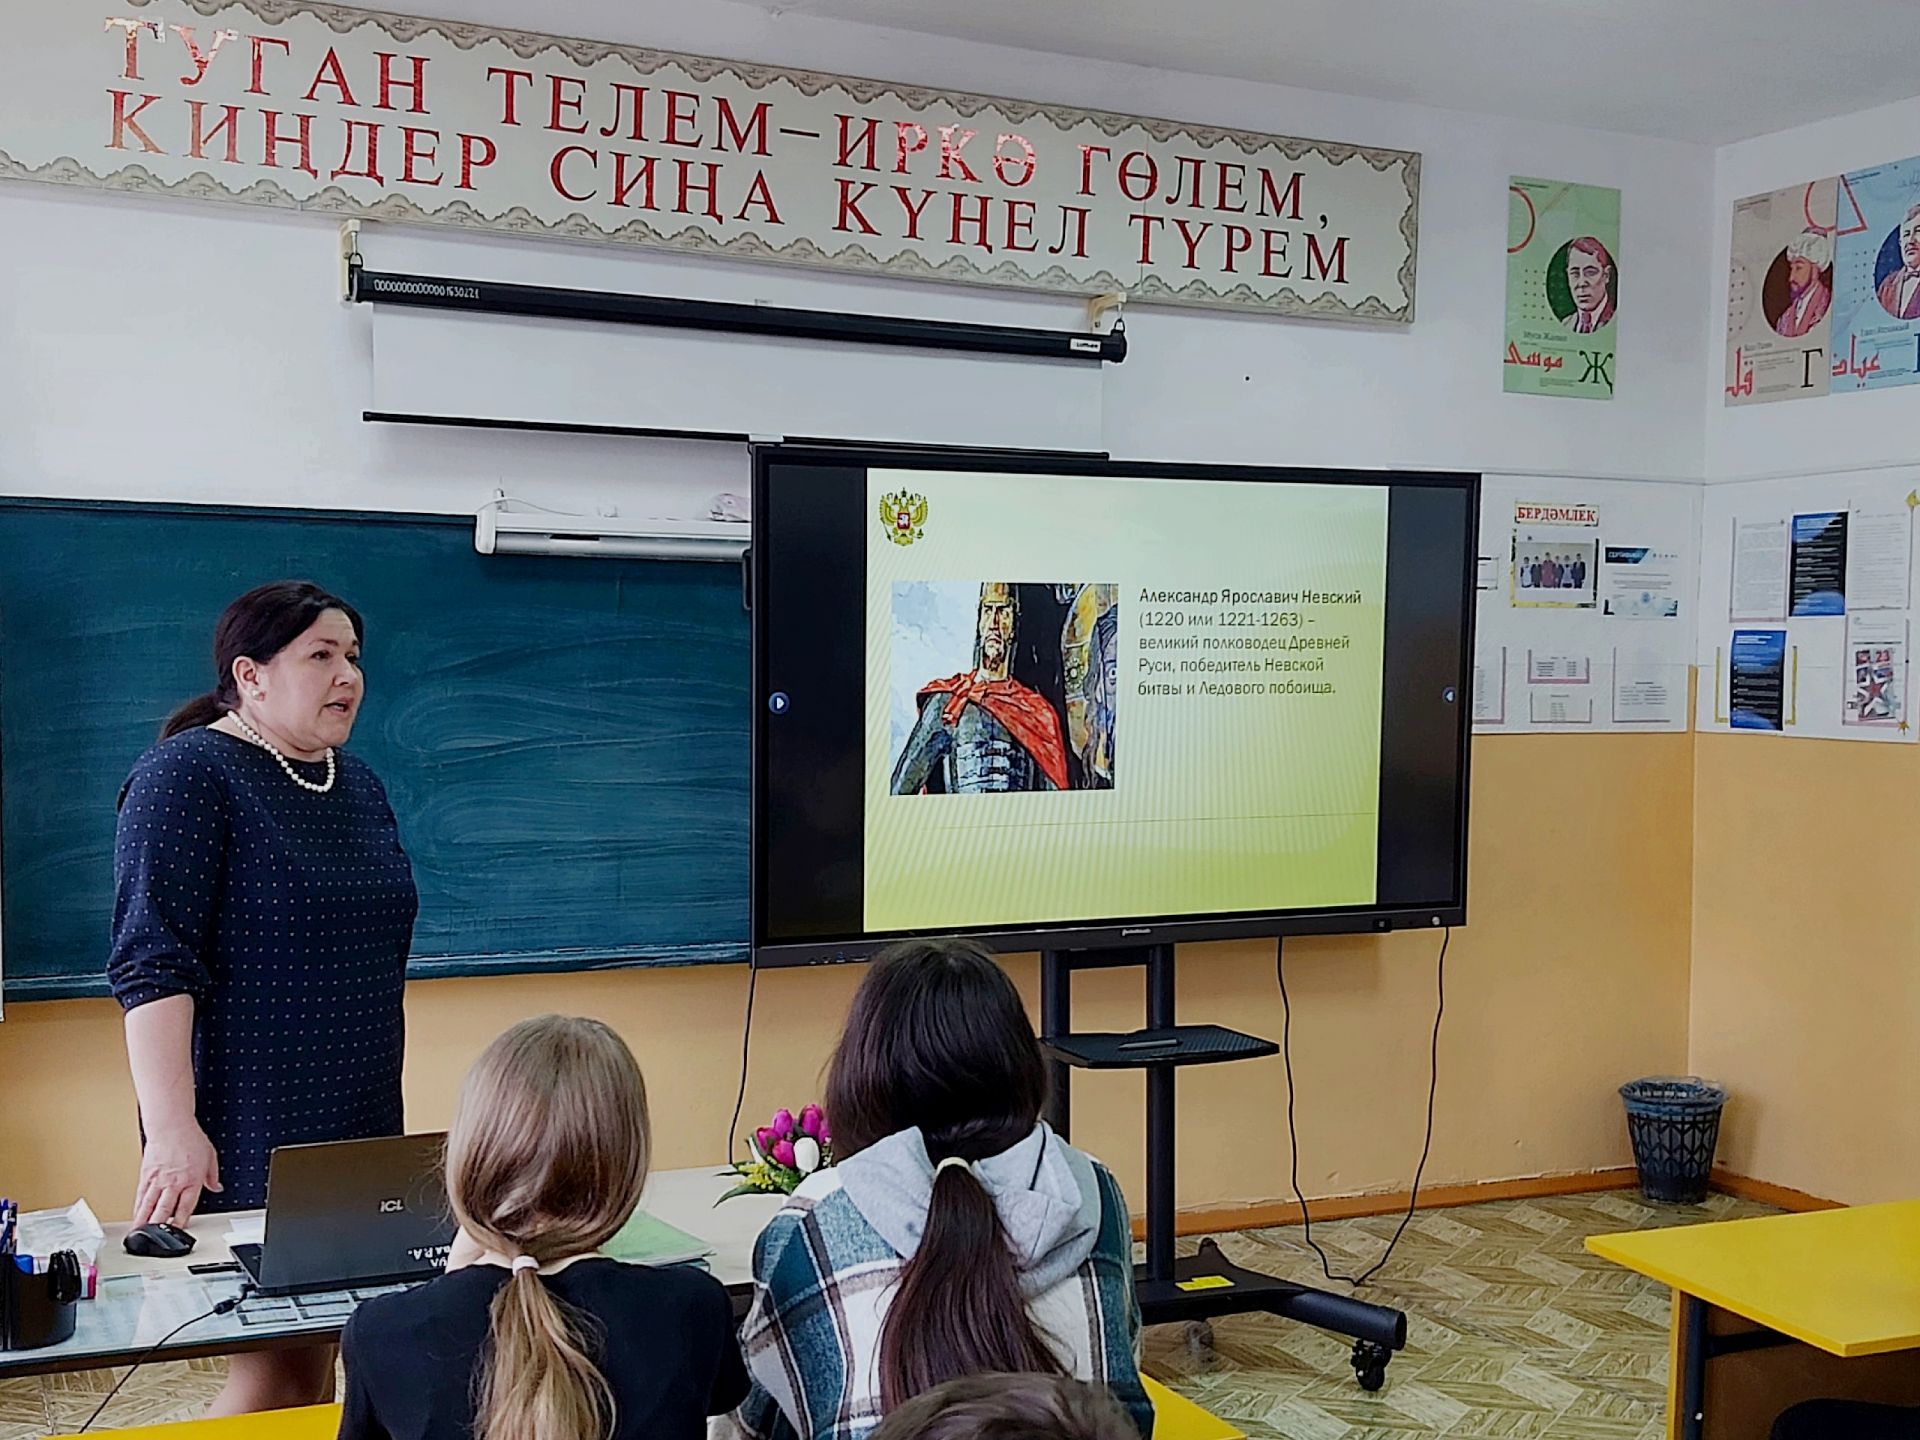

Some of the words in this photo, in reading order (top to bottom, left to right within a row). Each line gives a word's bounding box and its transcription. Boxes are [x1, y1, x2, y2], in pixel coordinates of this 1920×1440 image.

[104, 16, 431, 115] ТУГАН
[1078, 144, 1328, 230] ГӨЛЕМ,
[105, 89, 497, 191] КИҢДЕР
[550, 145, 785, 226] СИҢА
[832, 178, 1092, 259] КҮҢЕЛ
[1128, 213, 1351, 285] ТҮРЕМ
[1800, 348, 1823, 388] Г
[1517, 506, 1596, 522] БЕРДӘМЛЕК
[1139, 588, 1218, 605] Александр
[1221, 589, 1299, 605] Ярославич
[1302, 589, 1362, 604] Невский
[1139, 611, 1184, 628] (1220
[1188, 614, 1213, 627] или
[1217, 612, 1303, 628] 1221-1263)
[1139, 635, 1199, 650] великий
[1202, 638, 1286, 652] полководец
[1288, 635, 1350, 652] Древней
[1138, 657, 1176, 675] Руси,
[1180, 659, 1261, 673] победитель
[1264, 657, 1324, 672] Невской
[1138, 680, 1182, 696] битвы
[1186, 684, 1195, 695] и
[1199, 683, 1265, 696] Ледового
[1269, 680, 1336, 695] побоища.
